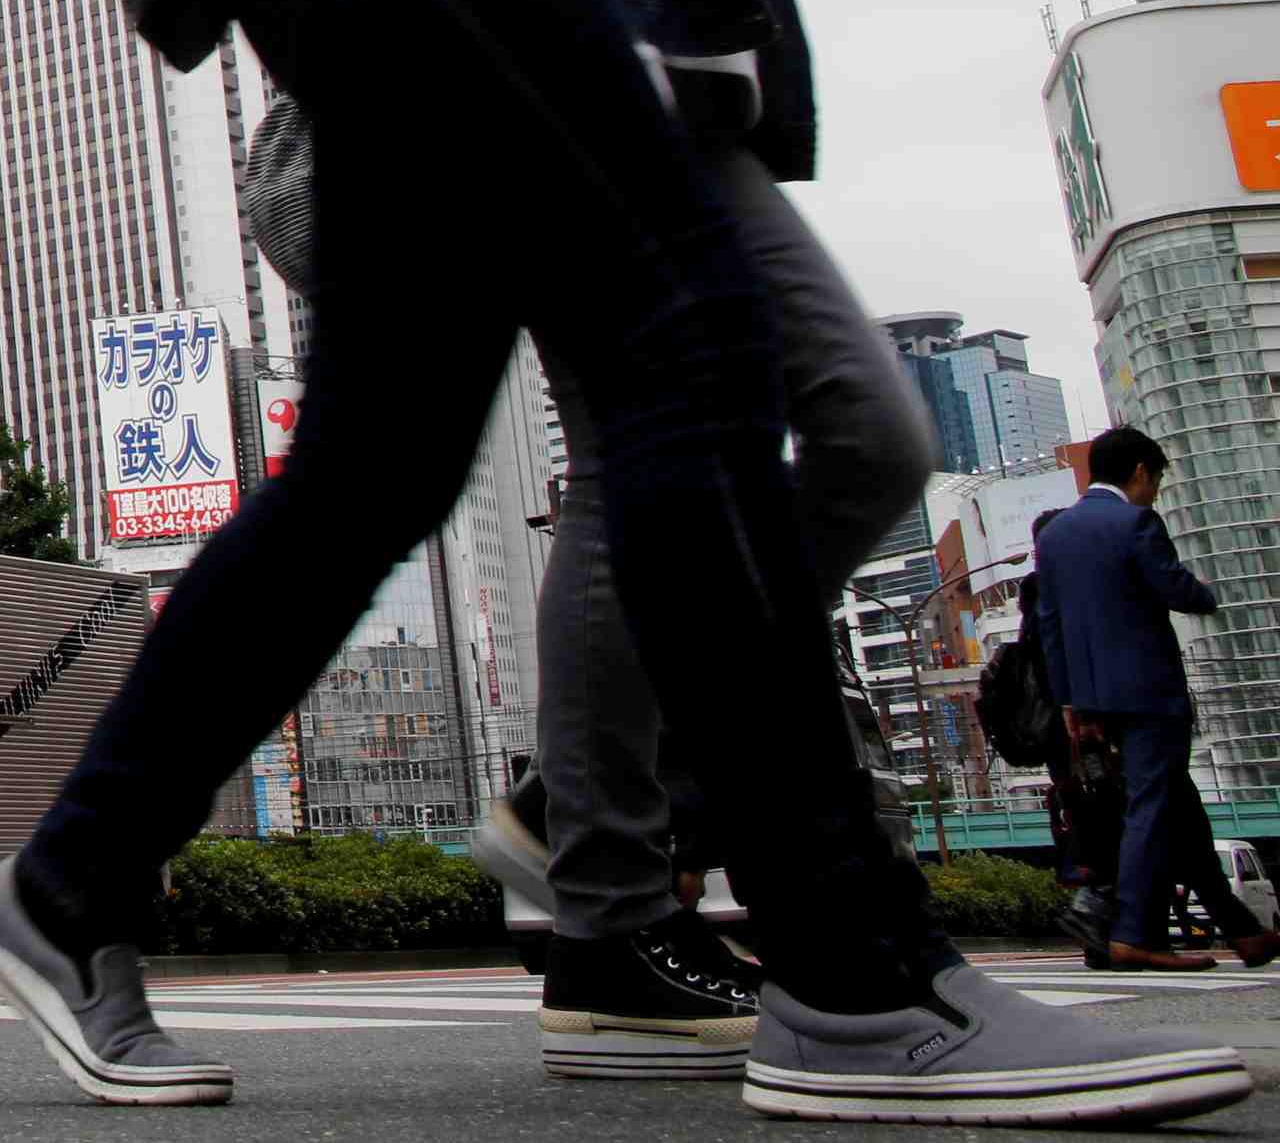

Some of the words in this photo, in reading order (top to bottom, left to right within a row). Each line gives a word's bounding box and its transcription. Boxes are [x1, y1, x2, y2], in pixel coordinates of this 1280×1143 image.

[99, 312, 220, 391] カラオケ
[148, 378, 177, 423] の
[113, 413, 221, 483] 鉄人
[113, 484, 231, 518] 1室最大100名収容
[116, 509, 233, 536] 03-3345-6430
